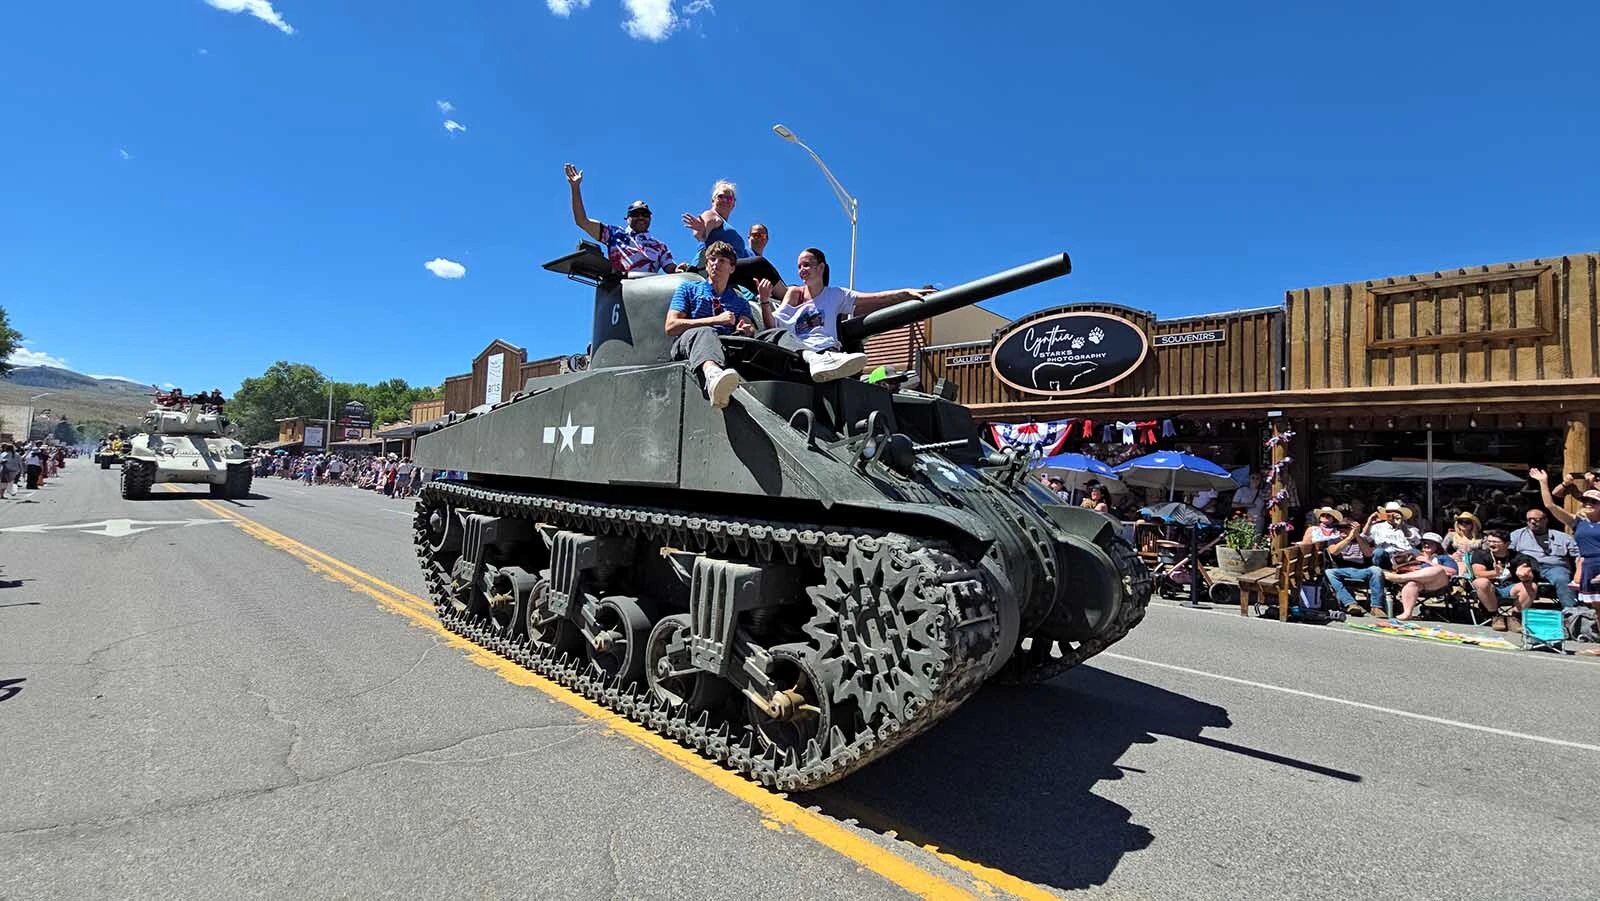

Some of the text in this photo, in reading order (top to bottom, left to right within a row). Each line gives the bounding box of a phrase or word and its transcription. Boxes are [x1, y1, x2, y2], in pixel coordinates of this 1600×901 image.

[611, 303, 620, 326] 6
[1024, 325, 1074, 357] Cynthia
[1161, 333, 1216, 344] SOUVENIRS
[1040, 350, 1073, 358] STARKS
[1047, 353, 1107, 362] PHOTOGRAPHY
[953, 356, 983, 364] GALLERY
